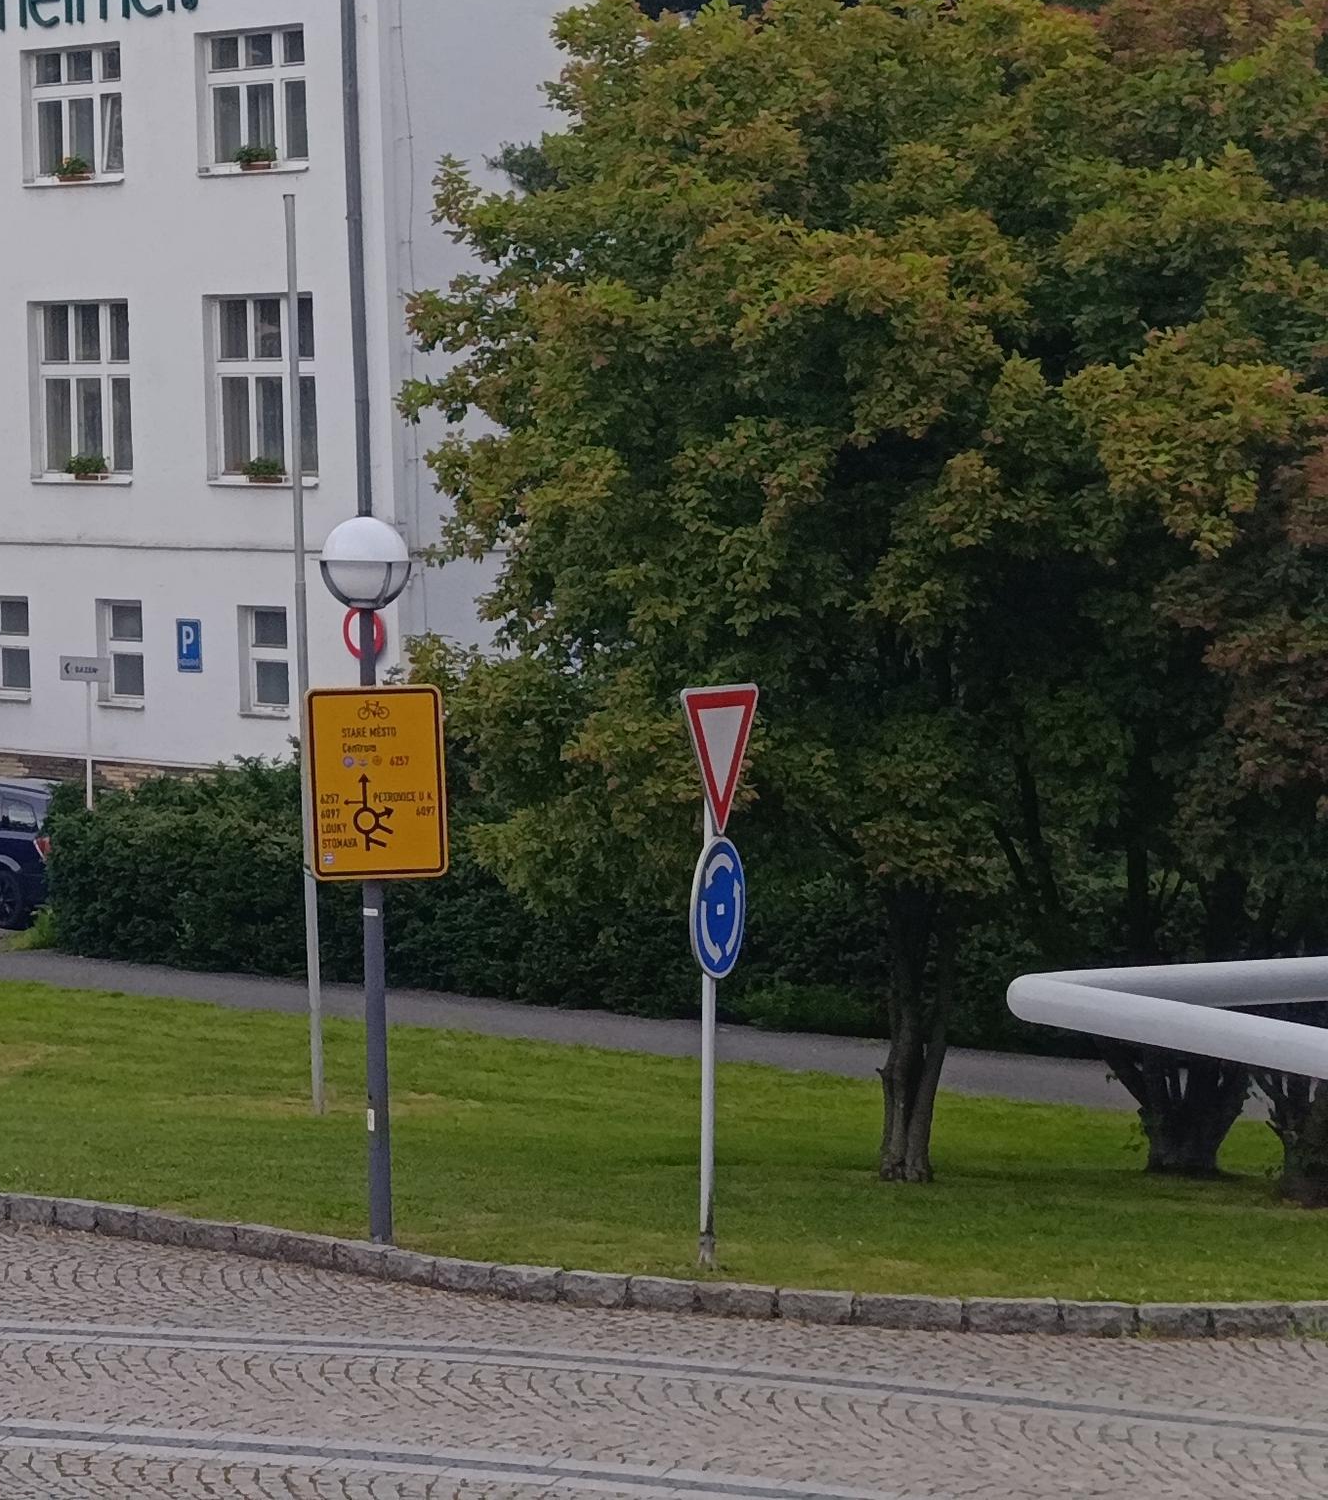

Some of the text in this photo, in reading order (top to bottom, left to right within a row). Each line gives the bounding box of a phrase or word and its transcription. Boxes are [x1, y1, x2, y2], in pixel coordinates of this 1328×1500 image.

[182, 626, 194, 654] P
[389, 756, 409, 766] 6257
[320, 794, 339, 804] 6257
[419, 792, 425, 802] U
[321, 809, 340, 819] 6097
[416, 806, 435, 816] 6097
